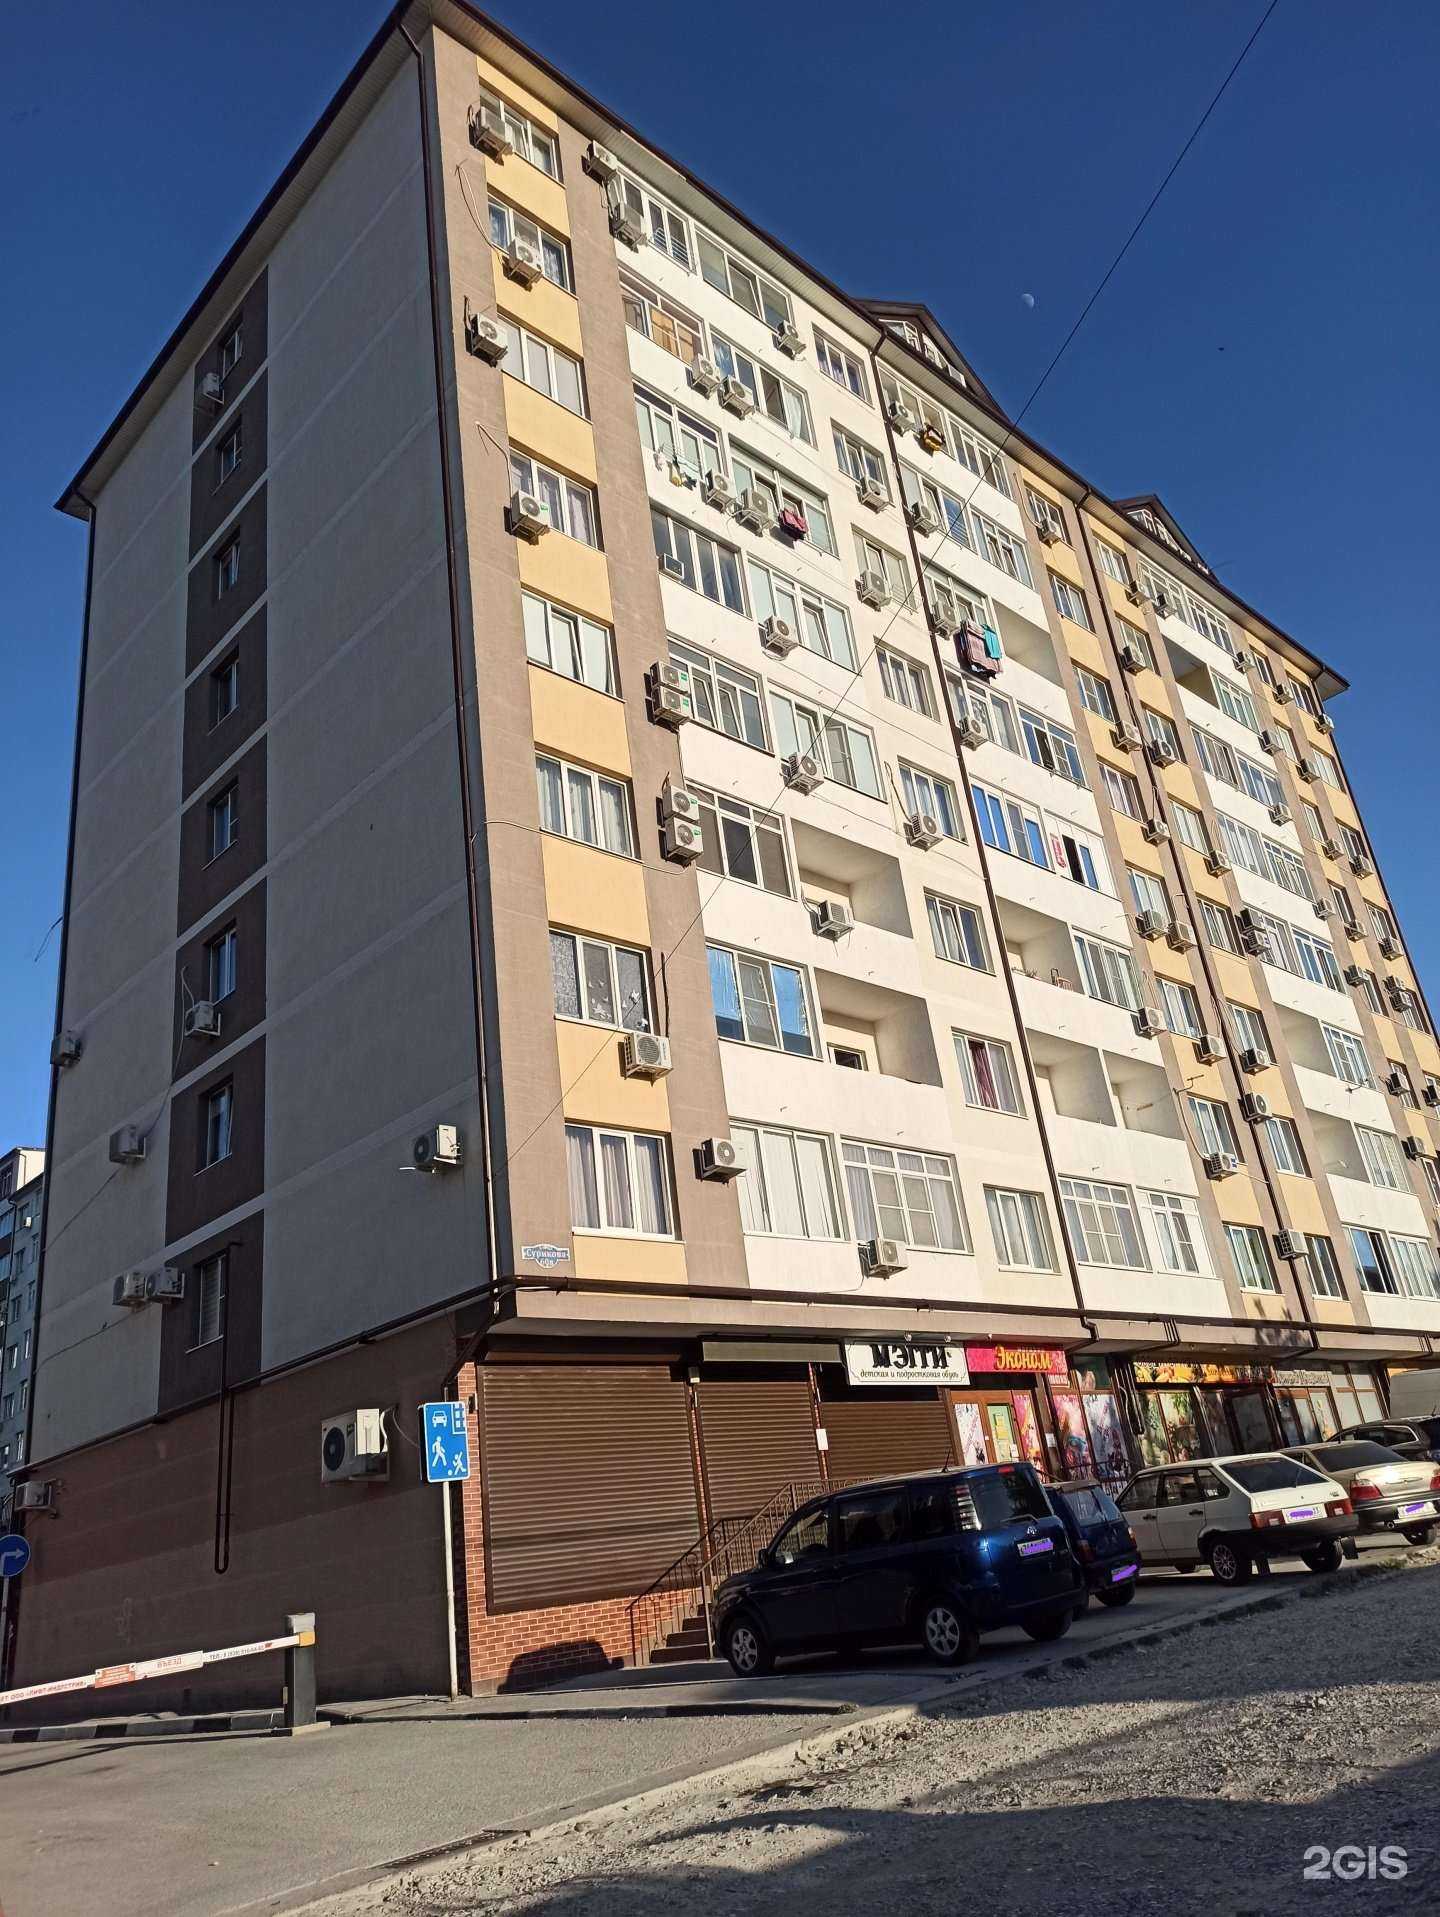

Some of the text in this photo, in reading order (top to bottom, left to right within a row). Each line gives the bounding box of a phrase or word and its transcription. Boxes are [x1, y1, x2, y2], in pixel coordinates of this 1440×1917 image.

[995, 1344, 1053, 1370] Эконом
[860, 1369, 889, 1378] детская
[896, 1371, 941, 1380] подростковая
[941, 1371, 959, 1381] обувь
